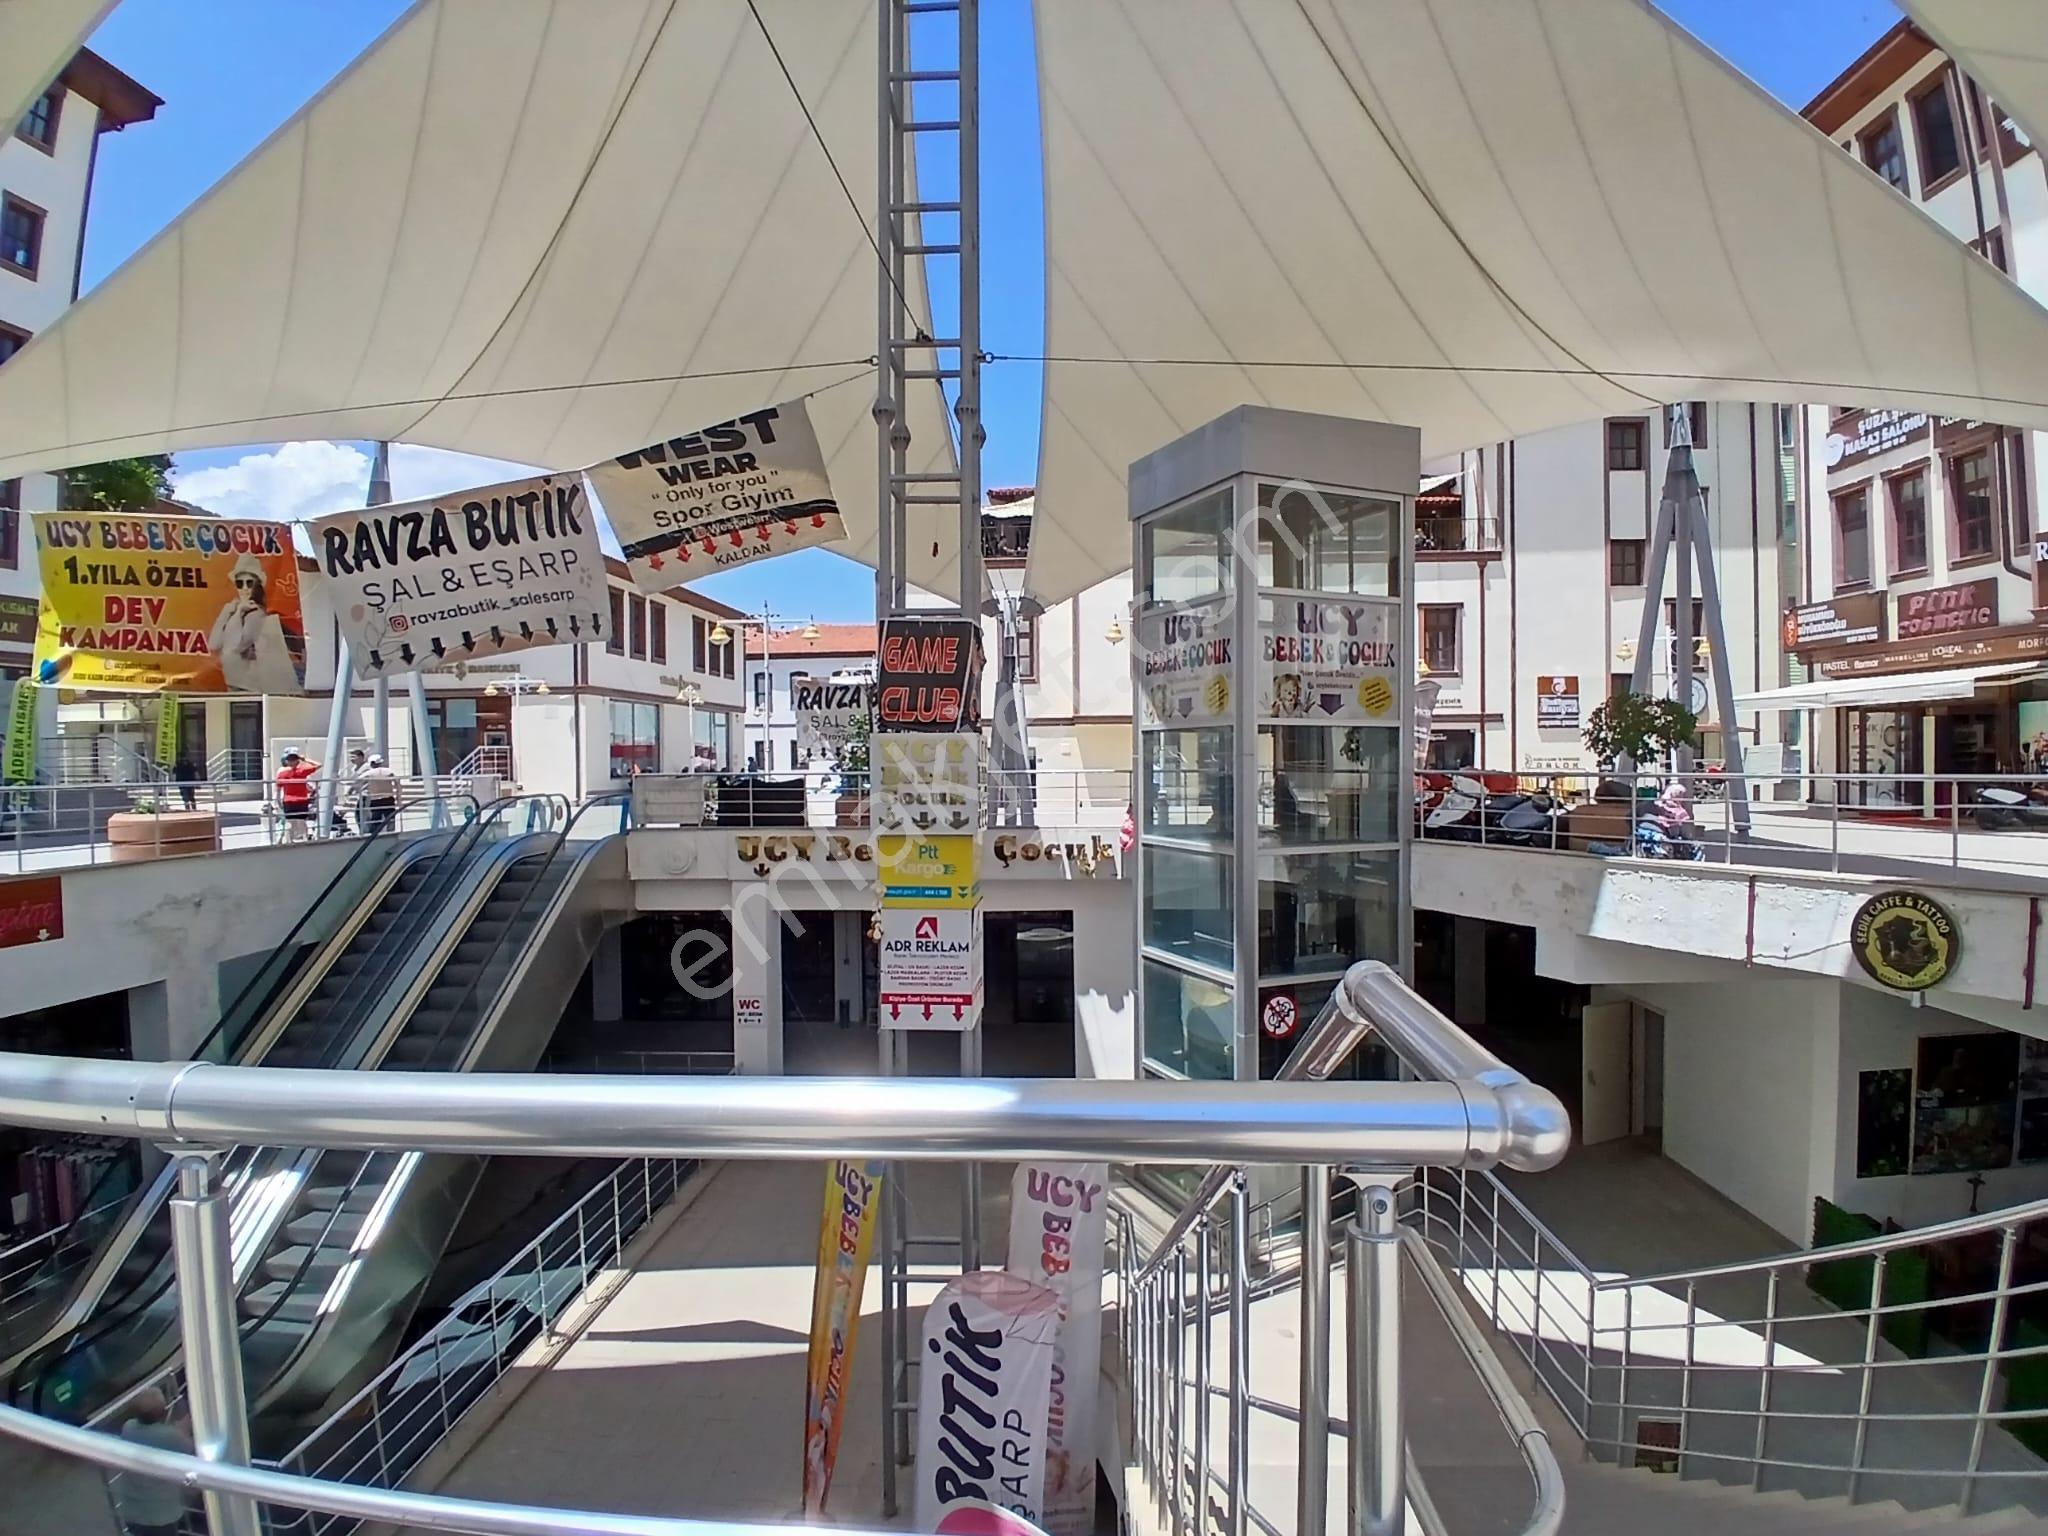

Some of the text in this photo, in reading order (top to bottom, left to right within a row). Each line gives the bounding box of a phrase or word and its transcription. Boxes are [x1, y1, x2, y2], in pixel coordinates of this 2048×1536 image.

[615, 407, 779, 470] WEST
[656, 452, 760, 487] WEAR
[666, 474, 767, 502] Only for you
[653, 486, 795, 529] Spor Giyim
[46, 520, 93, 548] UCY
[100, 522, 182, 551] BEBEK
[197, 524, 282, 559] ÇOCUK
[322, 477, 583, 578] RAVZA BUTİK
[714, 543, 771, 566] KALDAN
[147, 560, 208, 588] ÖZEL
[363, 548, 579, 613] ŞAL & EŞARP
[104, 595, 166, 626] DEV
[1297, 602, 1365, 636] UCY
[59, 627, 210, 655] KAMPANYA
[883, 636, 960, 674] GAME
[1189, 638, 1231, 672] ÇOCUK
[1263, 635, 1324, 665] BEBEK
[1339, 640, 1395, 669] ÇOCUK
[797, 686, 861, 710] RAVZA
[881, 686, 960, 723] CLUB
[11, 739, 25, 777] ADEM
[919, 845, 938, 859] Ptt
[1869, 895, 1904, 915] CAFFE
[1905, 896, 1913, 907] &
[1916, 899, 1950, 934] TATTOO
[885, 940, 970, 953] ADR REKLAM
[739, 1000, 760, 1009] WC
[836, 1161, 873, 1206] UCY
[1027, 1168, 1101, 1214] UCY
[928, 1302, 1002, 1503] BUTİK
